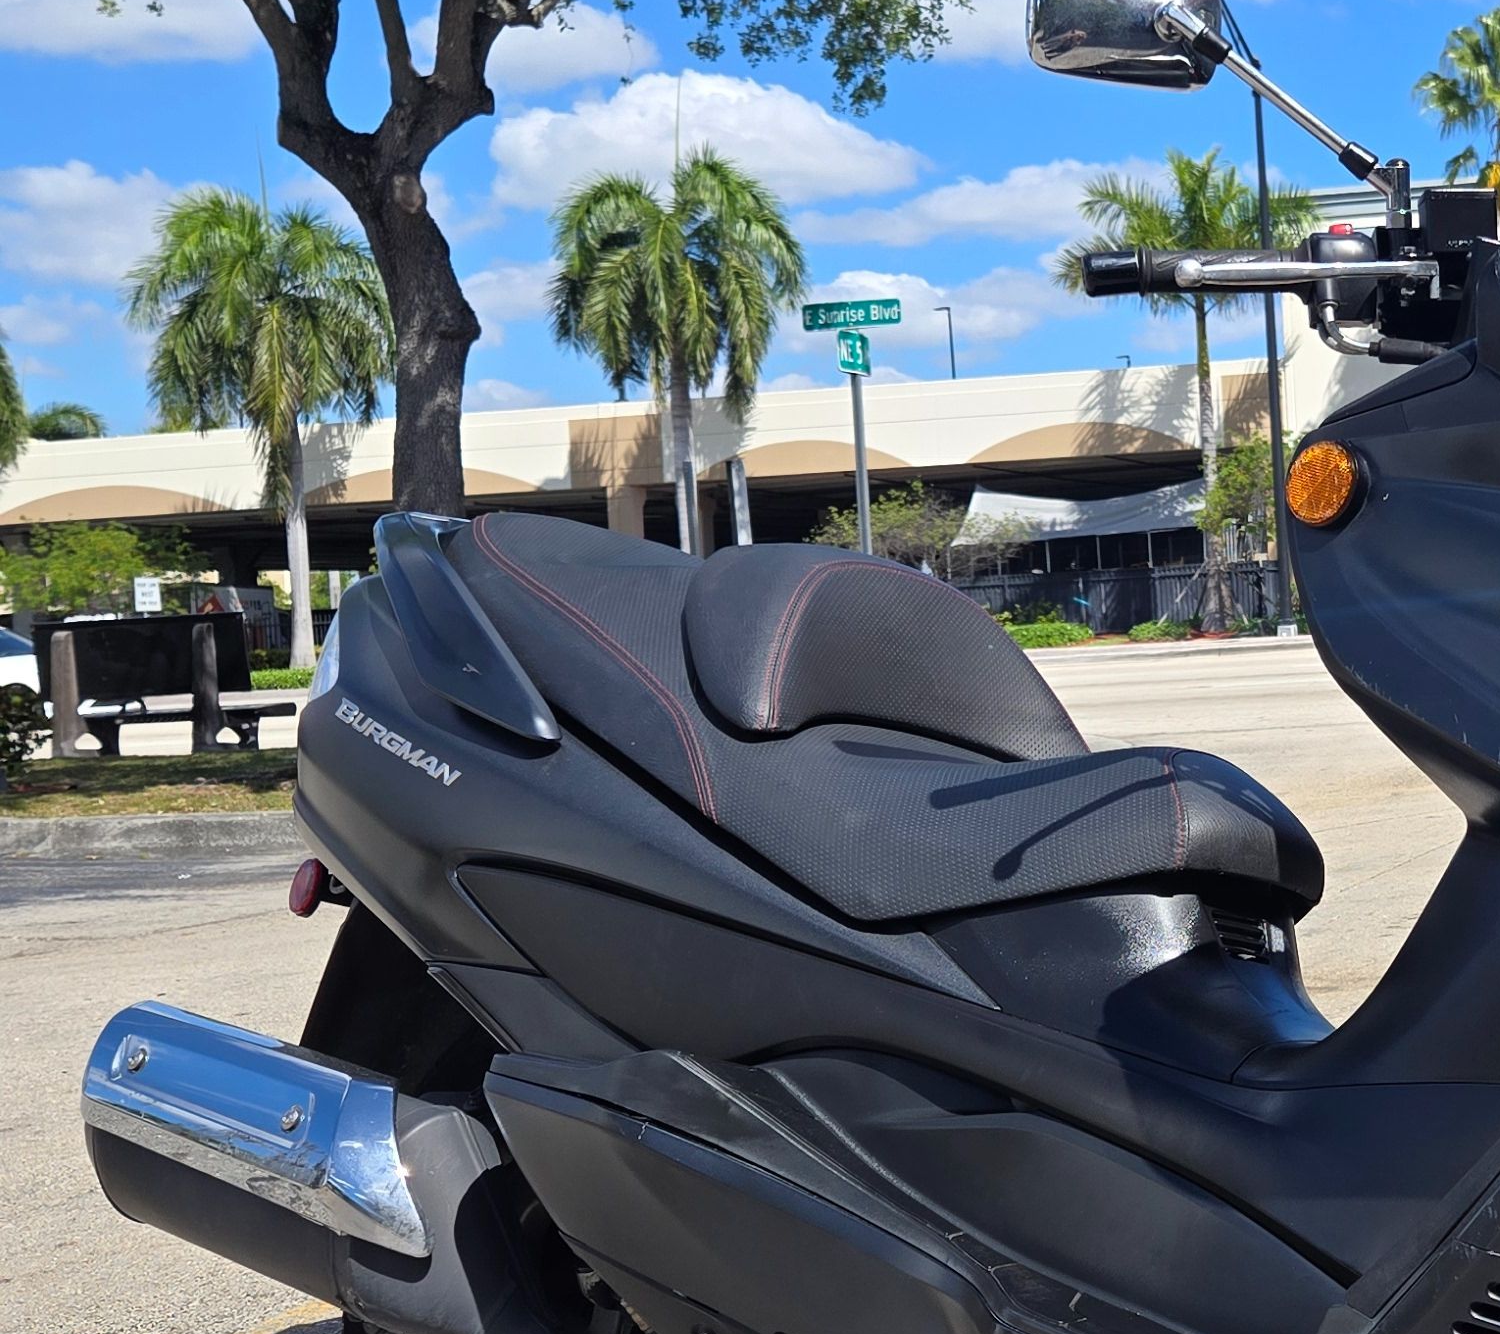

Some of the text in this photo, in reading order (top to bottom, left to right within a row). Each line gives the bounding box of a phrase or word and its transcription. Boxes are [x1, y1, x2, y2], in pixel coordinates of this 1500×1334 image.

[804, 304, 900, 326] E Sunrise Blvd
[840, 339, 854, 363] NE
[334, 697, 463, 787] BURGMAN
